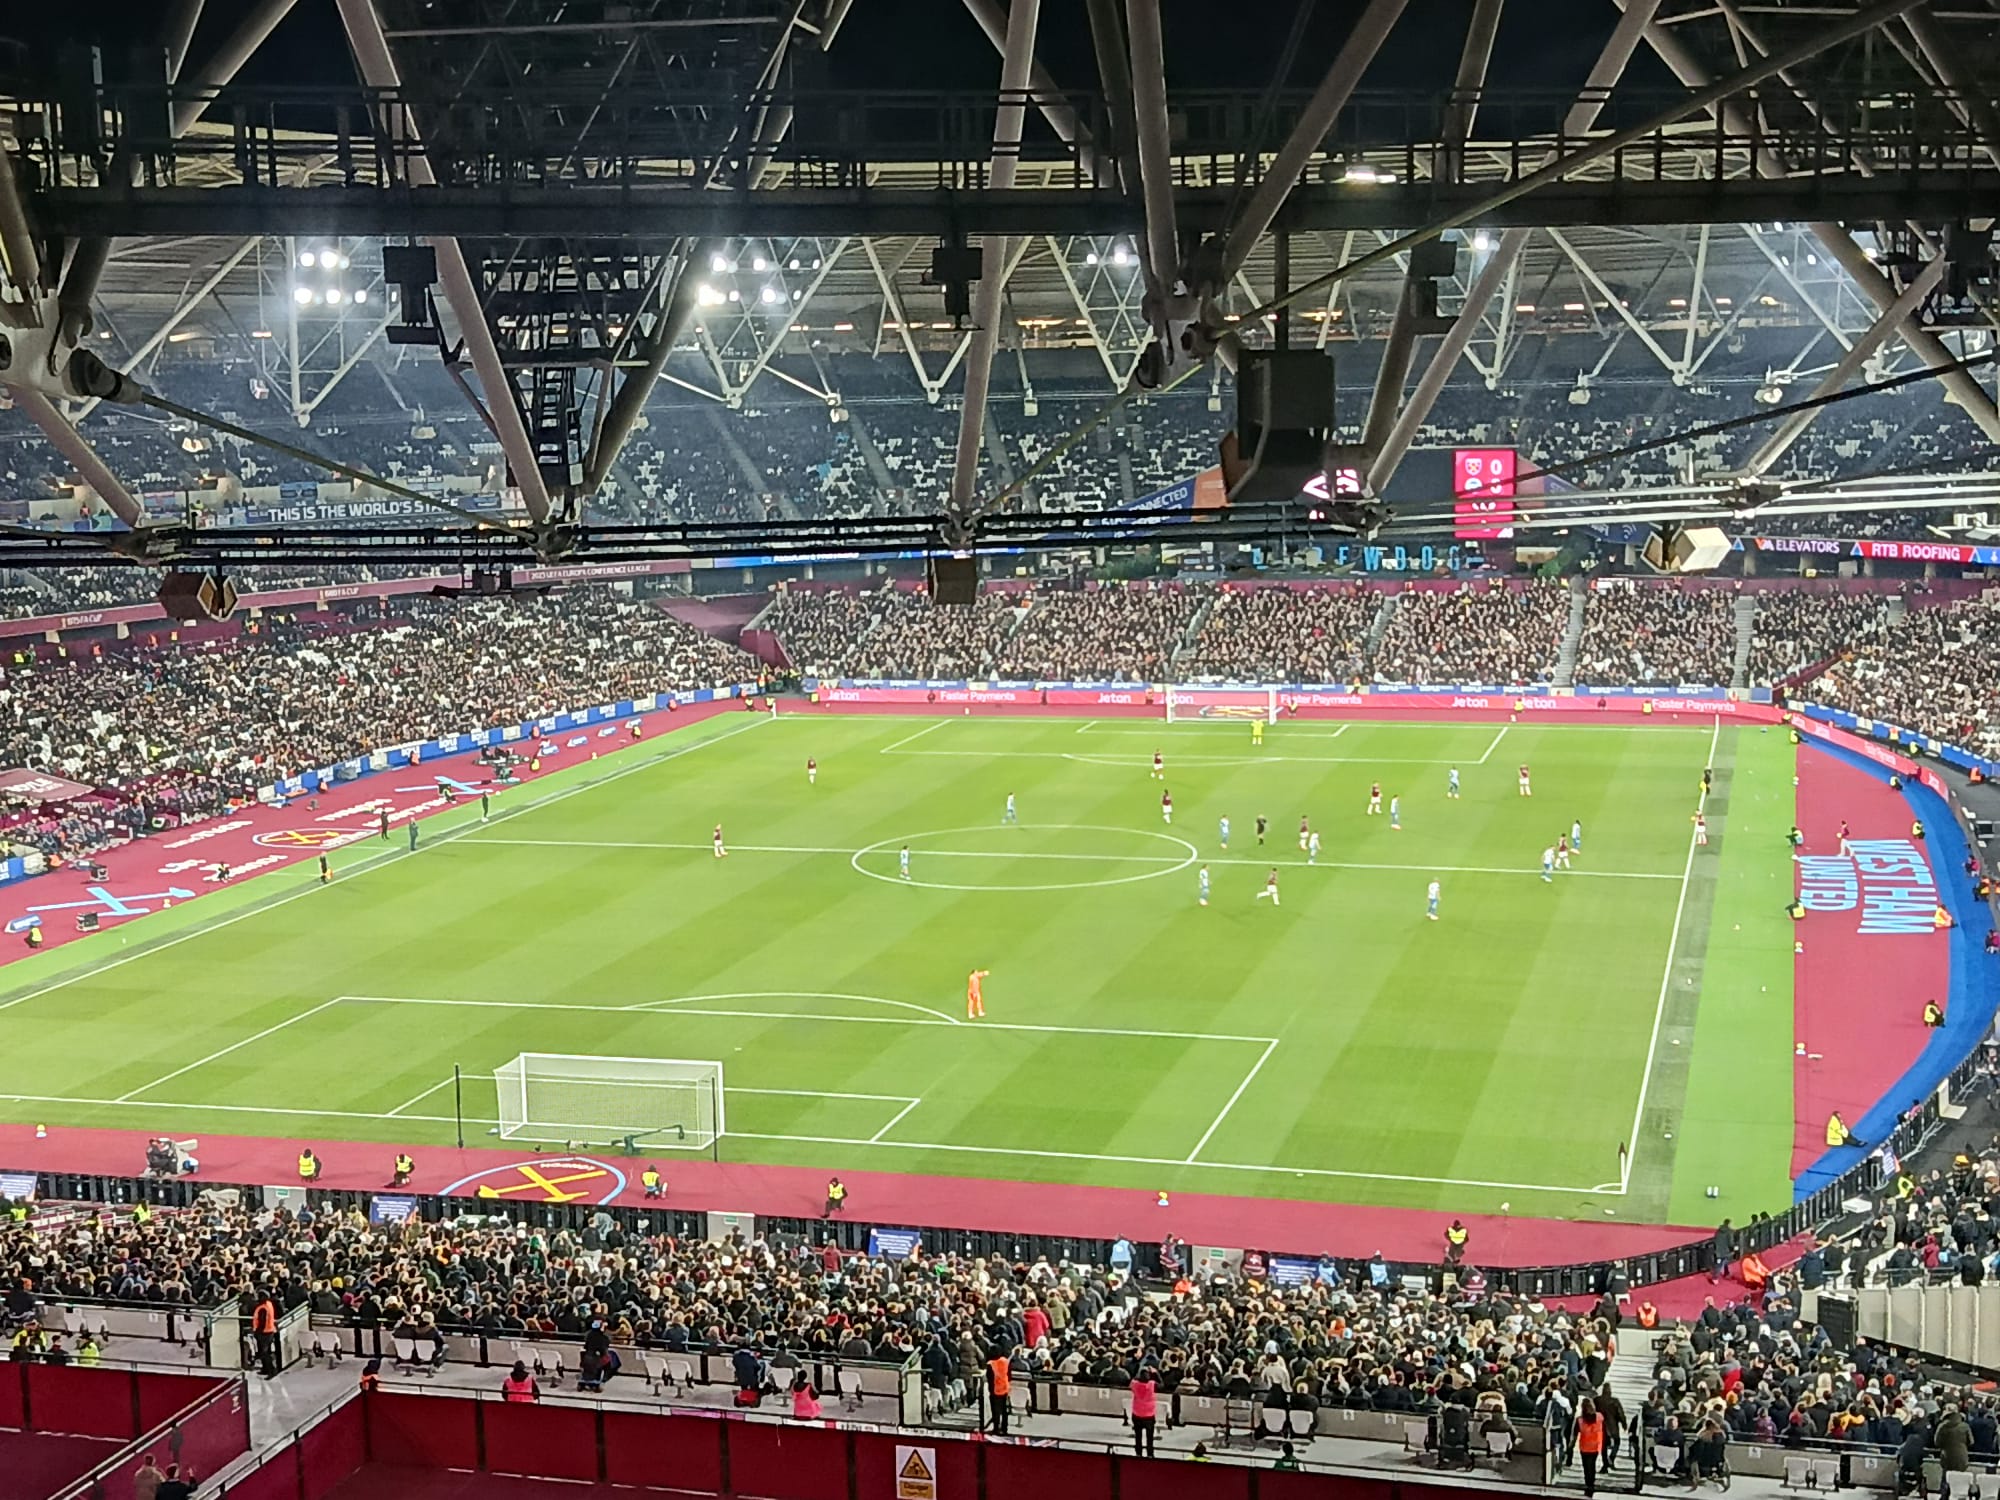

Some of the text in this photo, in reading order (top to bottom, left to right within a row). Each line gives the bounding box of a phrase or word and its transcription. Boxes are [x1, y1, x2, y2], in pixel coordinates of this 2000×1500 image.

[1490, 458, 1503, 475] 0
[268, 507, 300, 522] THIS
[303, 506, 316, 520] IS
[318, 504, 347, 519] THE
[349, 500, 412, 517] WORLD'S
[1776, 539, 1840, 554] ELEVATORS
[1871, 544, 1961, 562] RTB ROOFING
[828, 690, 859, 701] Jeton
[940, 690, 1016, 703] Faster Payments
[1098, 692, 1131, 704] Jeton
[1312, 694, 1362, 707] Payments
[1451, 696, 1488, 709] Jeton
[1652, 699, 1684, 710] Faster
[1799, 855, 1859, 911] UNITED
[1857, 886, 1938, 934] HAM
